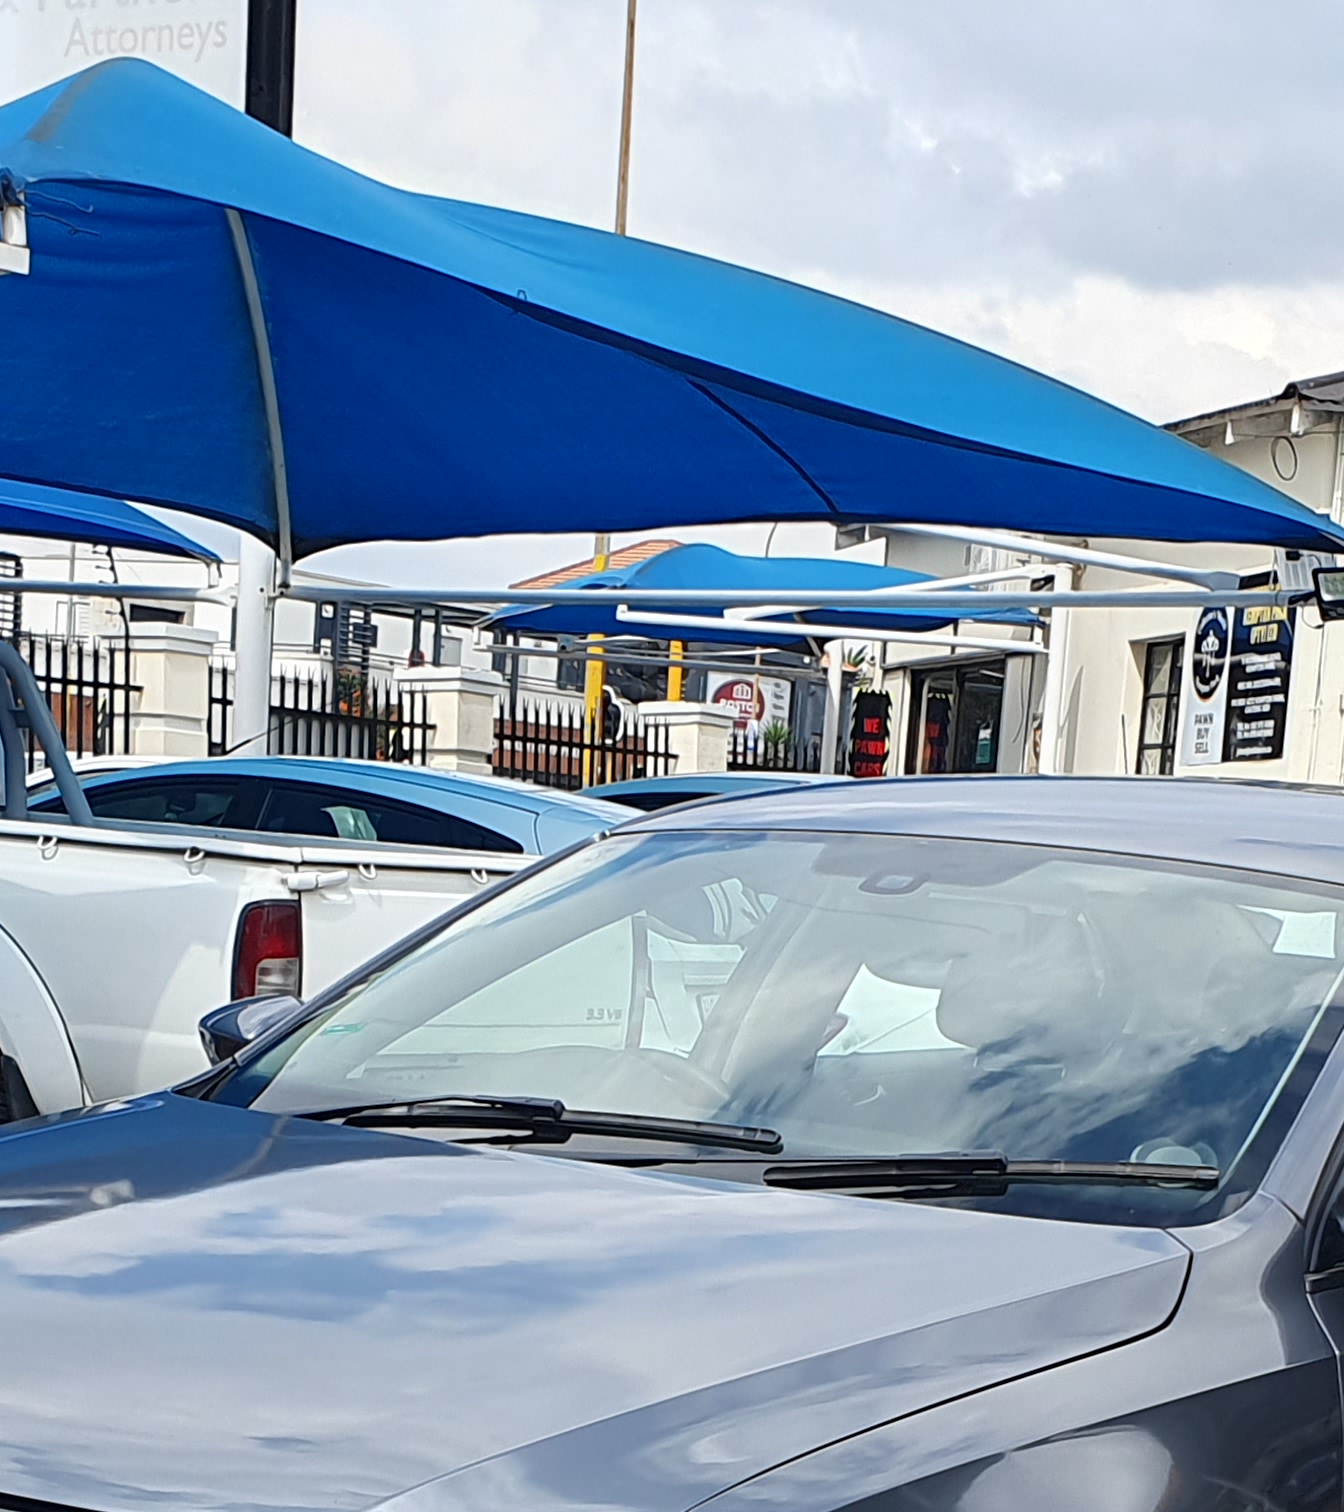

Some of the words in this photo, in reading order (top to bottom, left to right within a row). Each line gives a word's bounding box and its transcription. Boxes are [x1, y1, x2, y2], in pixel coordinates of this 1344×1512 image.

[64, 17, 228, 63] Attorneys
[863, 717, 881, 734] WE
[855, 740, 886, 756] PAWN
